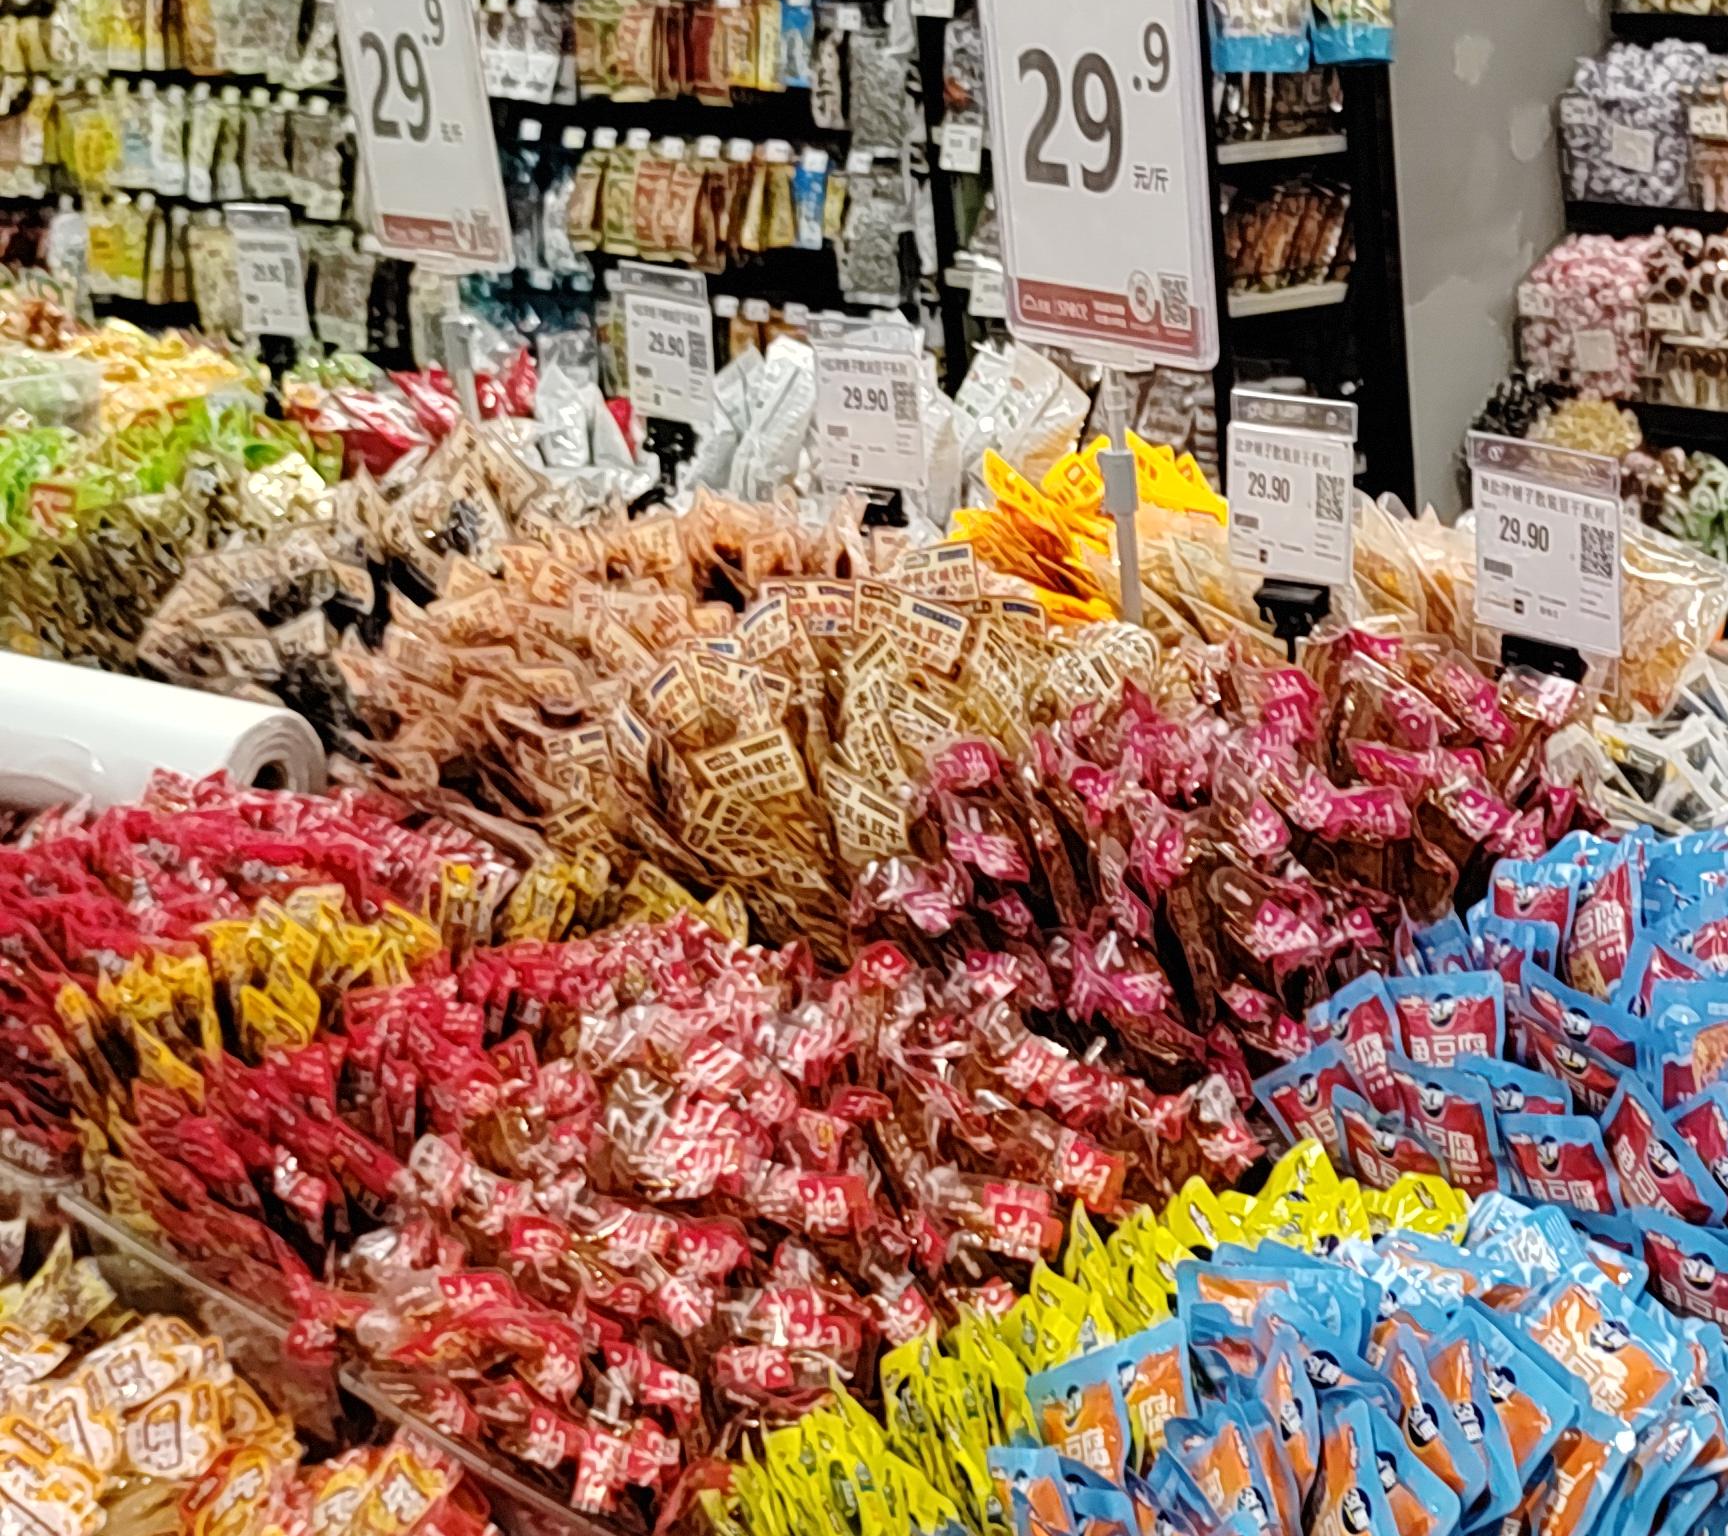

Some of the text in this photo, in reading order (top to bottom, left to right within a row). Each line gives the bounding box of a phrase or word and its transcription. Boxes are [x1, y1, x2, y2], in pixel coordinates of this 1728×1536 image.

[842, 385, 889, 412] 29.90
[1248, 470, 1291, 504] 29.90
[1498, 514, 1550, 552] 29.90
